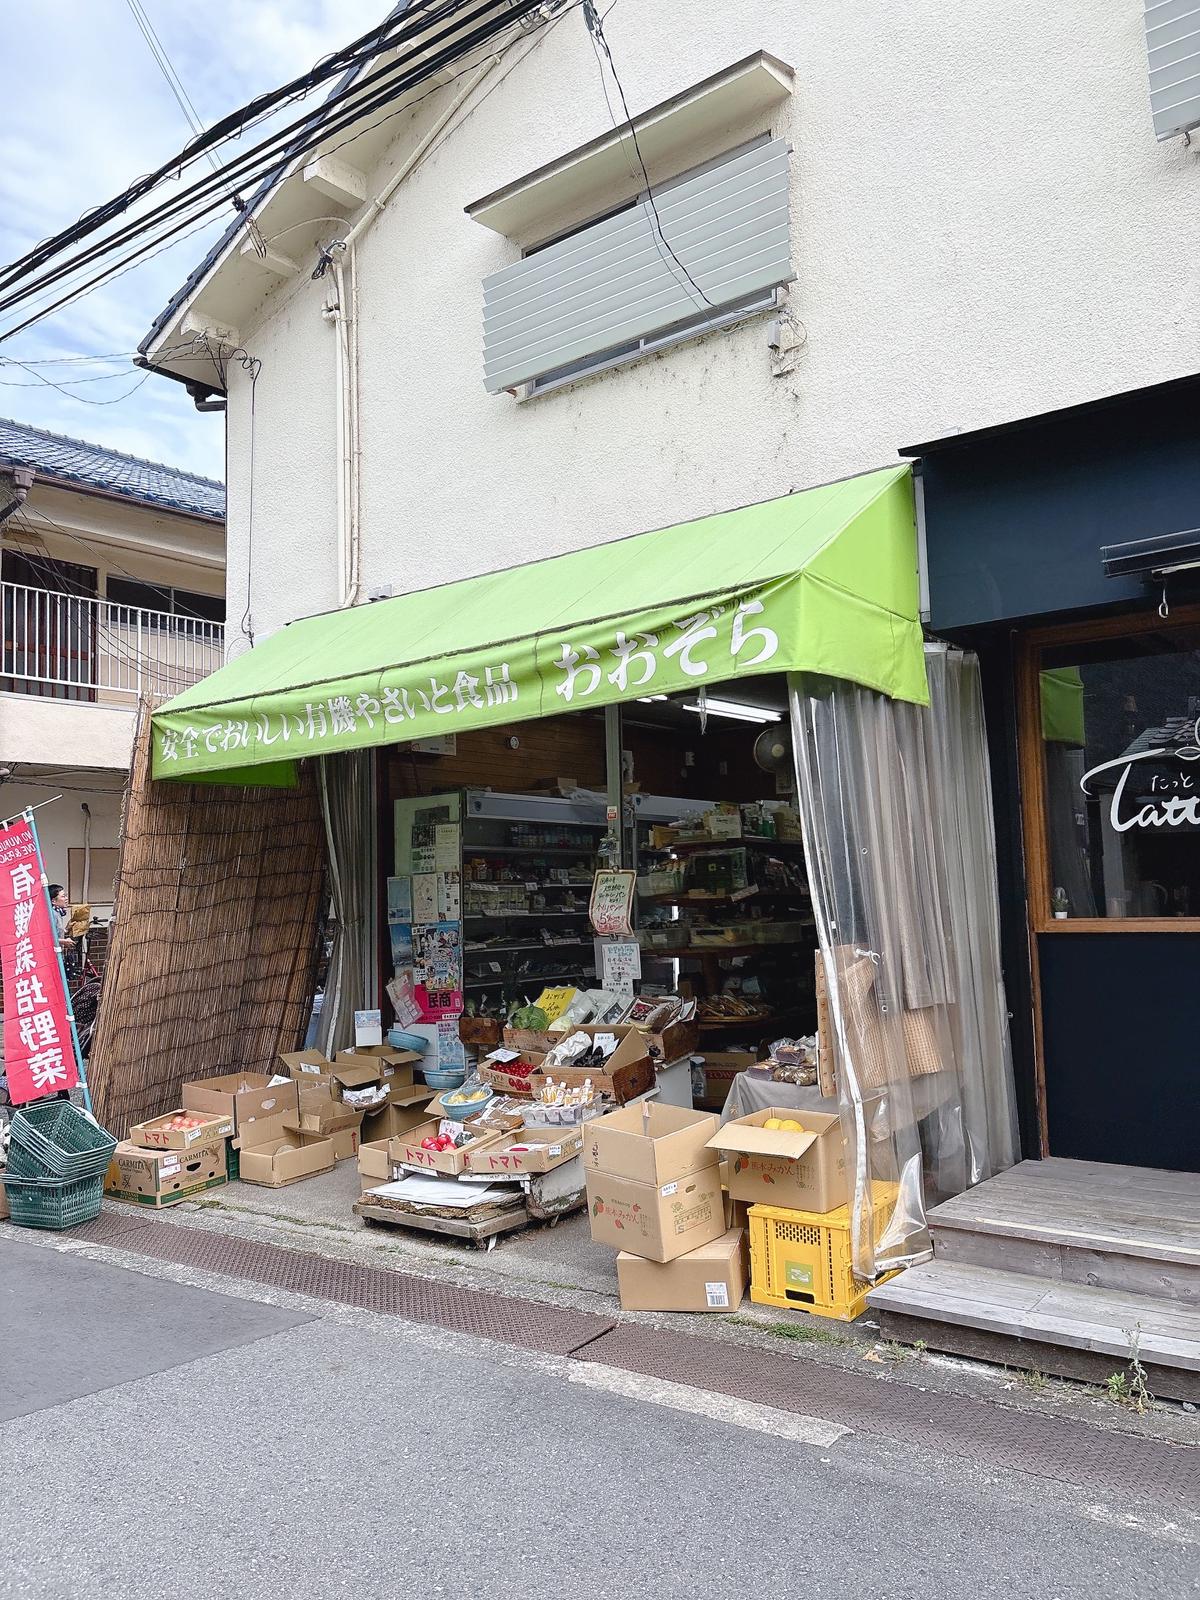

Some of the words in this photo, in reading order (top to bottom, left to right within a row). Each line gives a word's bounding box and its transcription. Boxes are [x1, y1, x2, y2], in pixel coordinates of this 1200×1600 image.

[161, 662, 519, 763] 安全でおいしい有機やさいと食品
[553, 600, 779, 701] おおぞら
[1152, 772, 1194, 791] たっと
[144, 1132, 170, 1145] トマト
[180, 1149, 209, 1164] CARMITA
[406, 1149, 436, 1166] トマト
[489, 1155, 523, 1169] トマト
[118, 1158, 145, 1171] CARMITA
